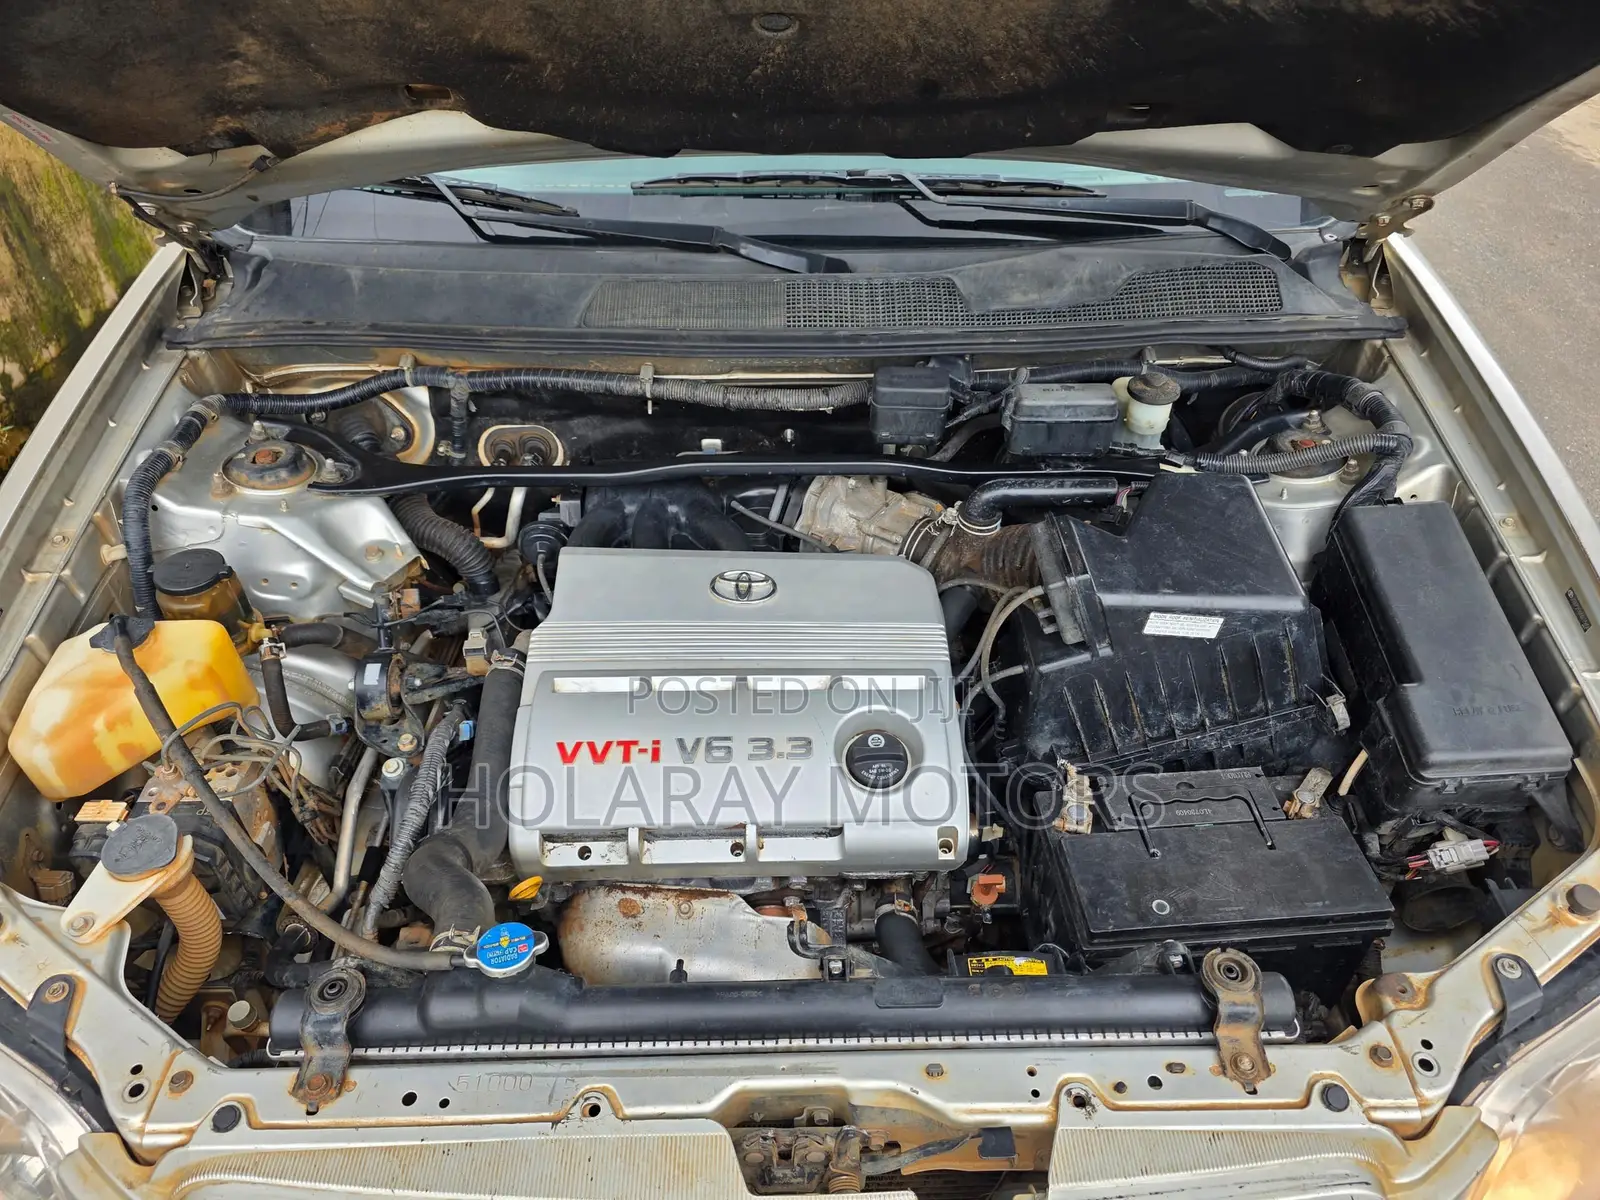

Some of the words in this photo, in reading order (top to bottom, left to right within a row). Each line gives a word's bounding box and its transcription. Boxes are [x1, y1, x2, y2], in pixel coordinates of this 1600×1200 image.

[556, 739, 661, 765] VVT-i
[675, 736, 733, 764] V6
[747, 736, 814, 761] 3.3
[490, 954, 518, 965] RADIATOR
